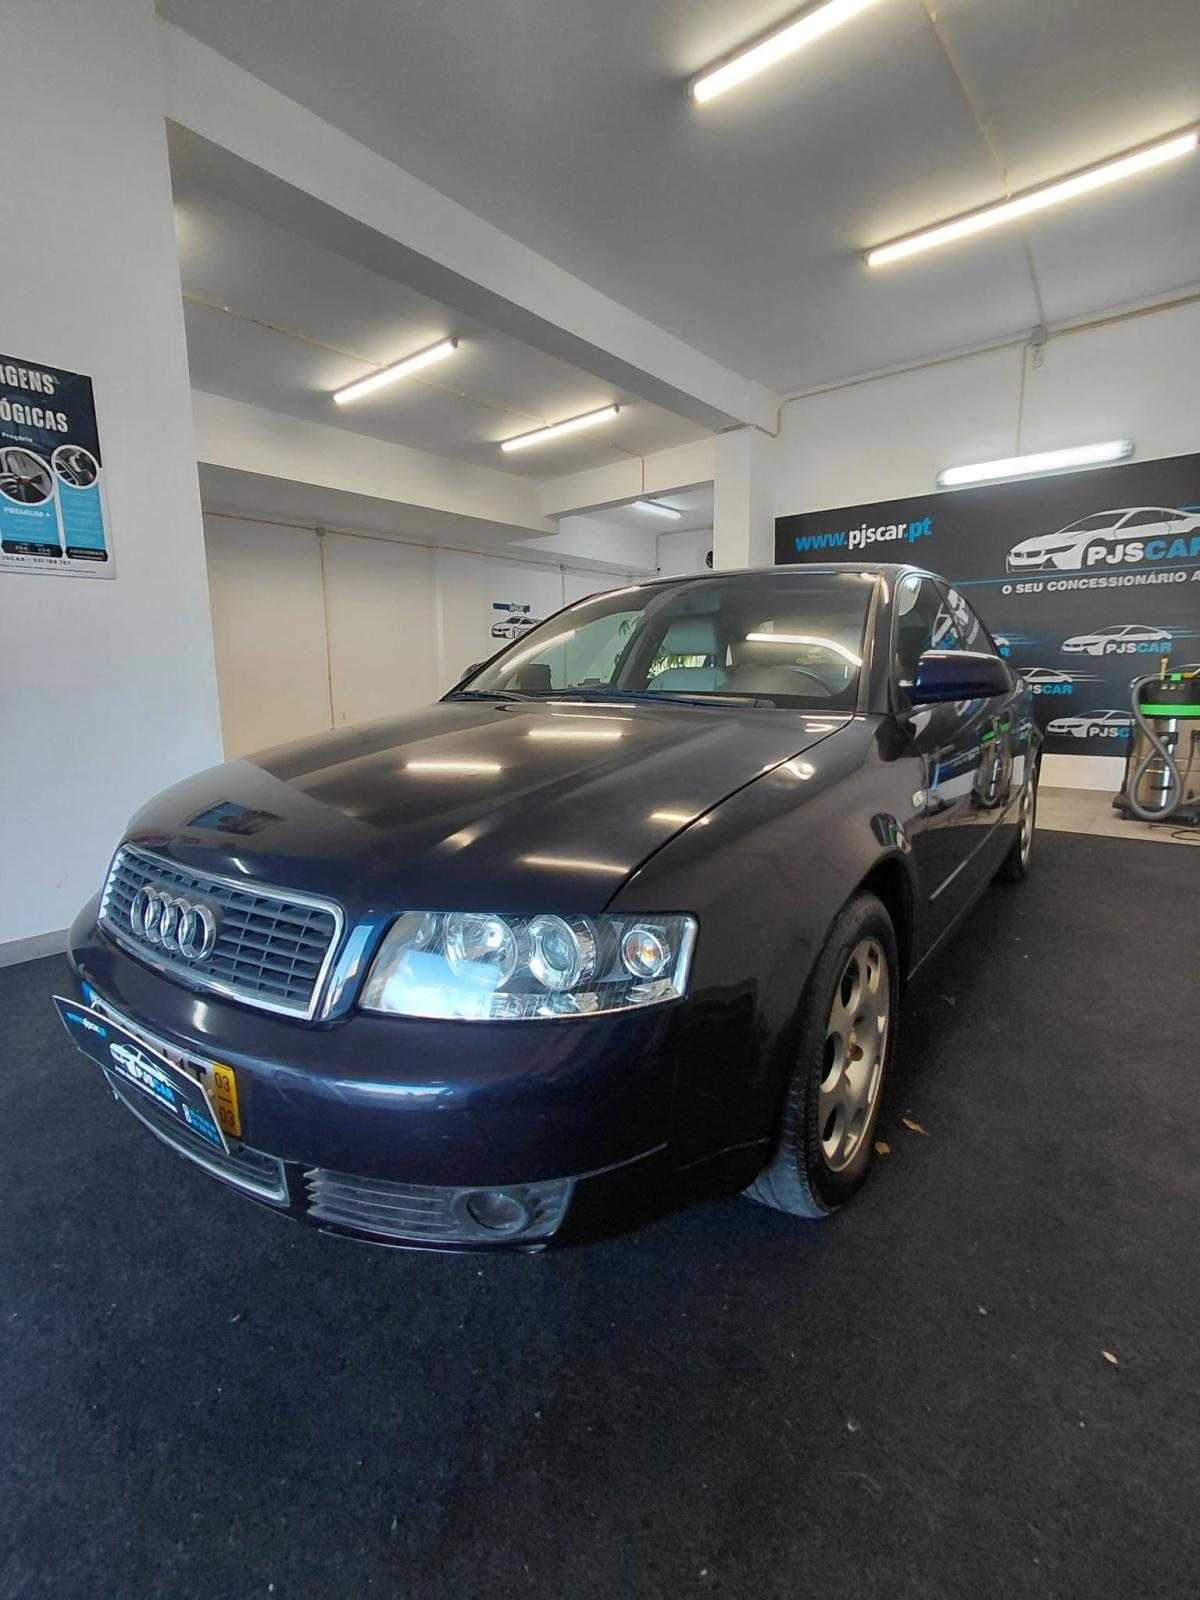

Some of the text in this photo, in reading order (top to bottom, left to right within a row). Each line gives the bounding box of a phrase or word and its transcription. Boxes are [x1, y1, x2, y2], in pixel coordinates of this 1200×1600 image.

[795, 516, 932, 551] www.pjscar.pt
[1002, 584, 1013, 596] O
[1016, 581, 1044, 595] SEU
[1047, 569, 1187, 592] CONCESSIONÁRIO
[1106, 641, 1173, 655] PJSCAR
